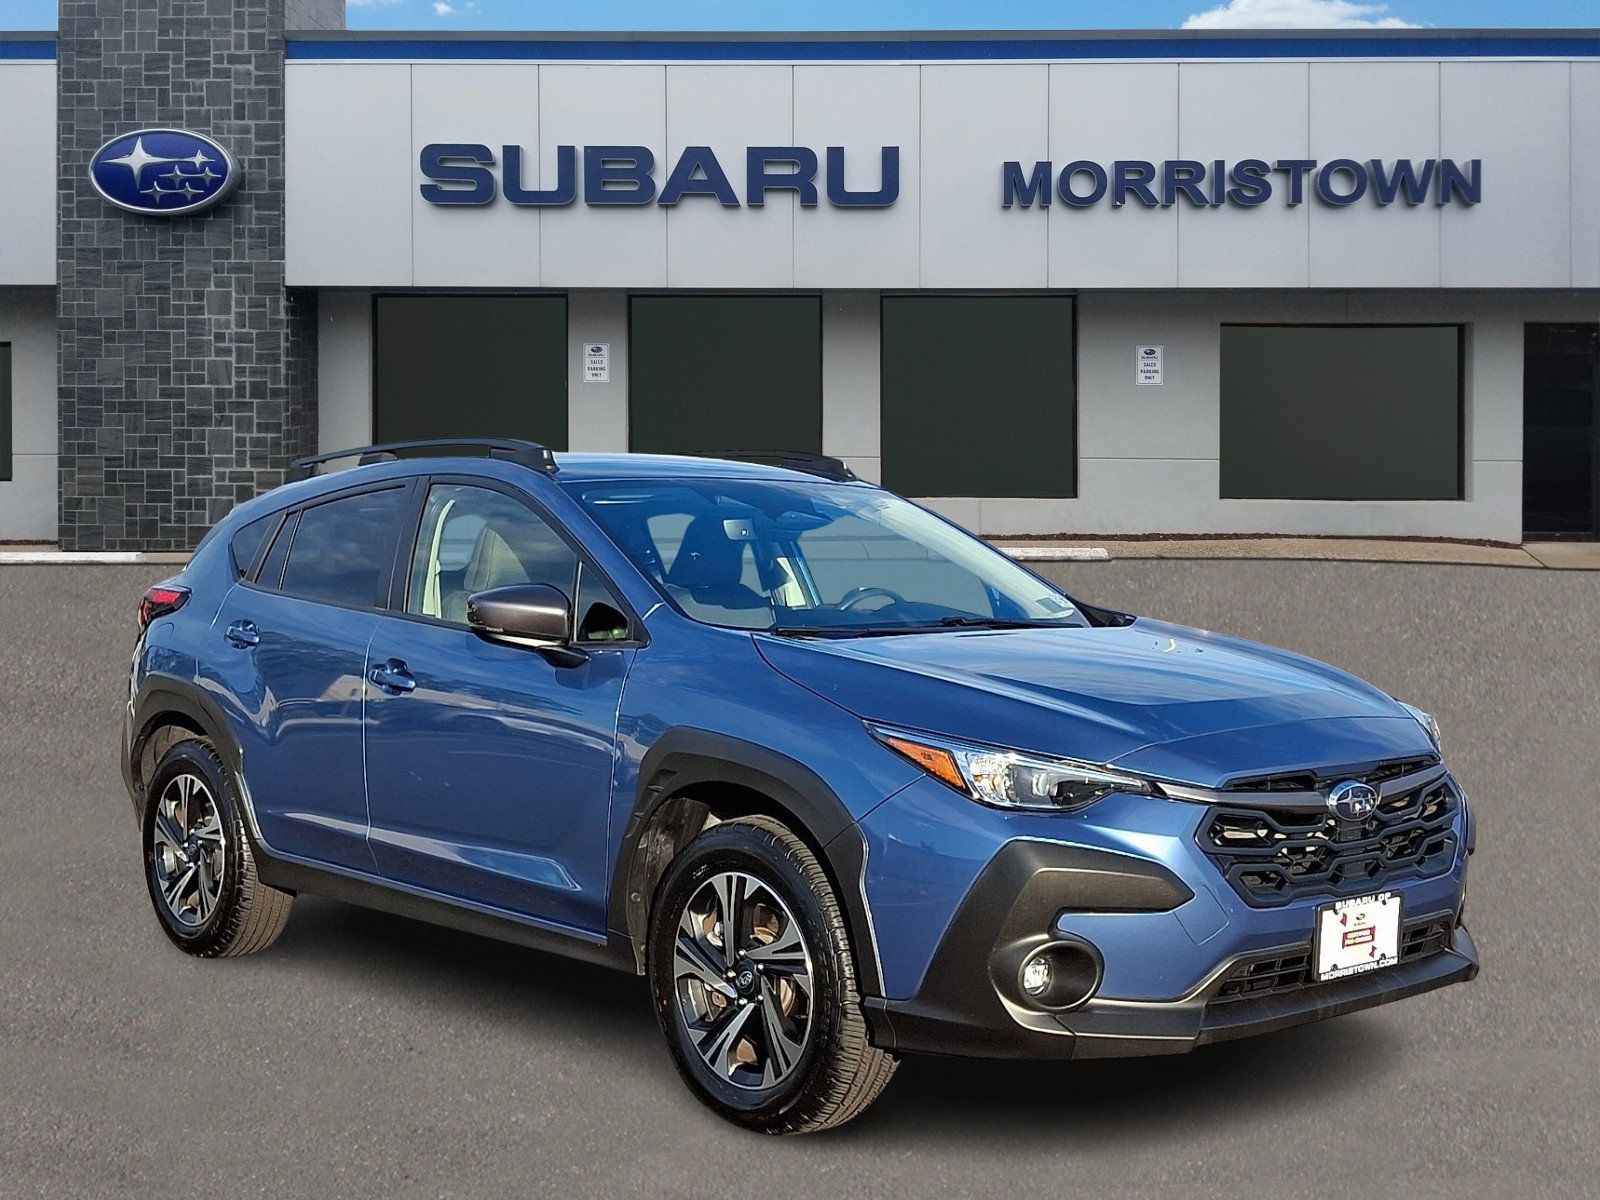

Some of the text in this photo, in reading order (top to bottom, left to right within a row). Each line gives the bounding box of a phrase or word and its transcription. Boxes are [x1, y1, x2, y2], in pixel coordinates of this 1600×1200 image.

[419, 143, 1482, 209] SUBARU MORRISTOWN
[1335, 894, 1376, 910] SUBARU
